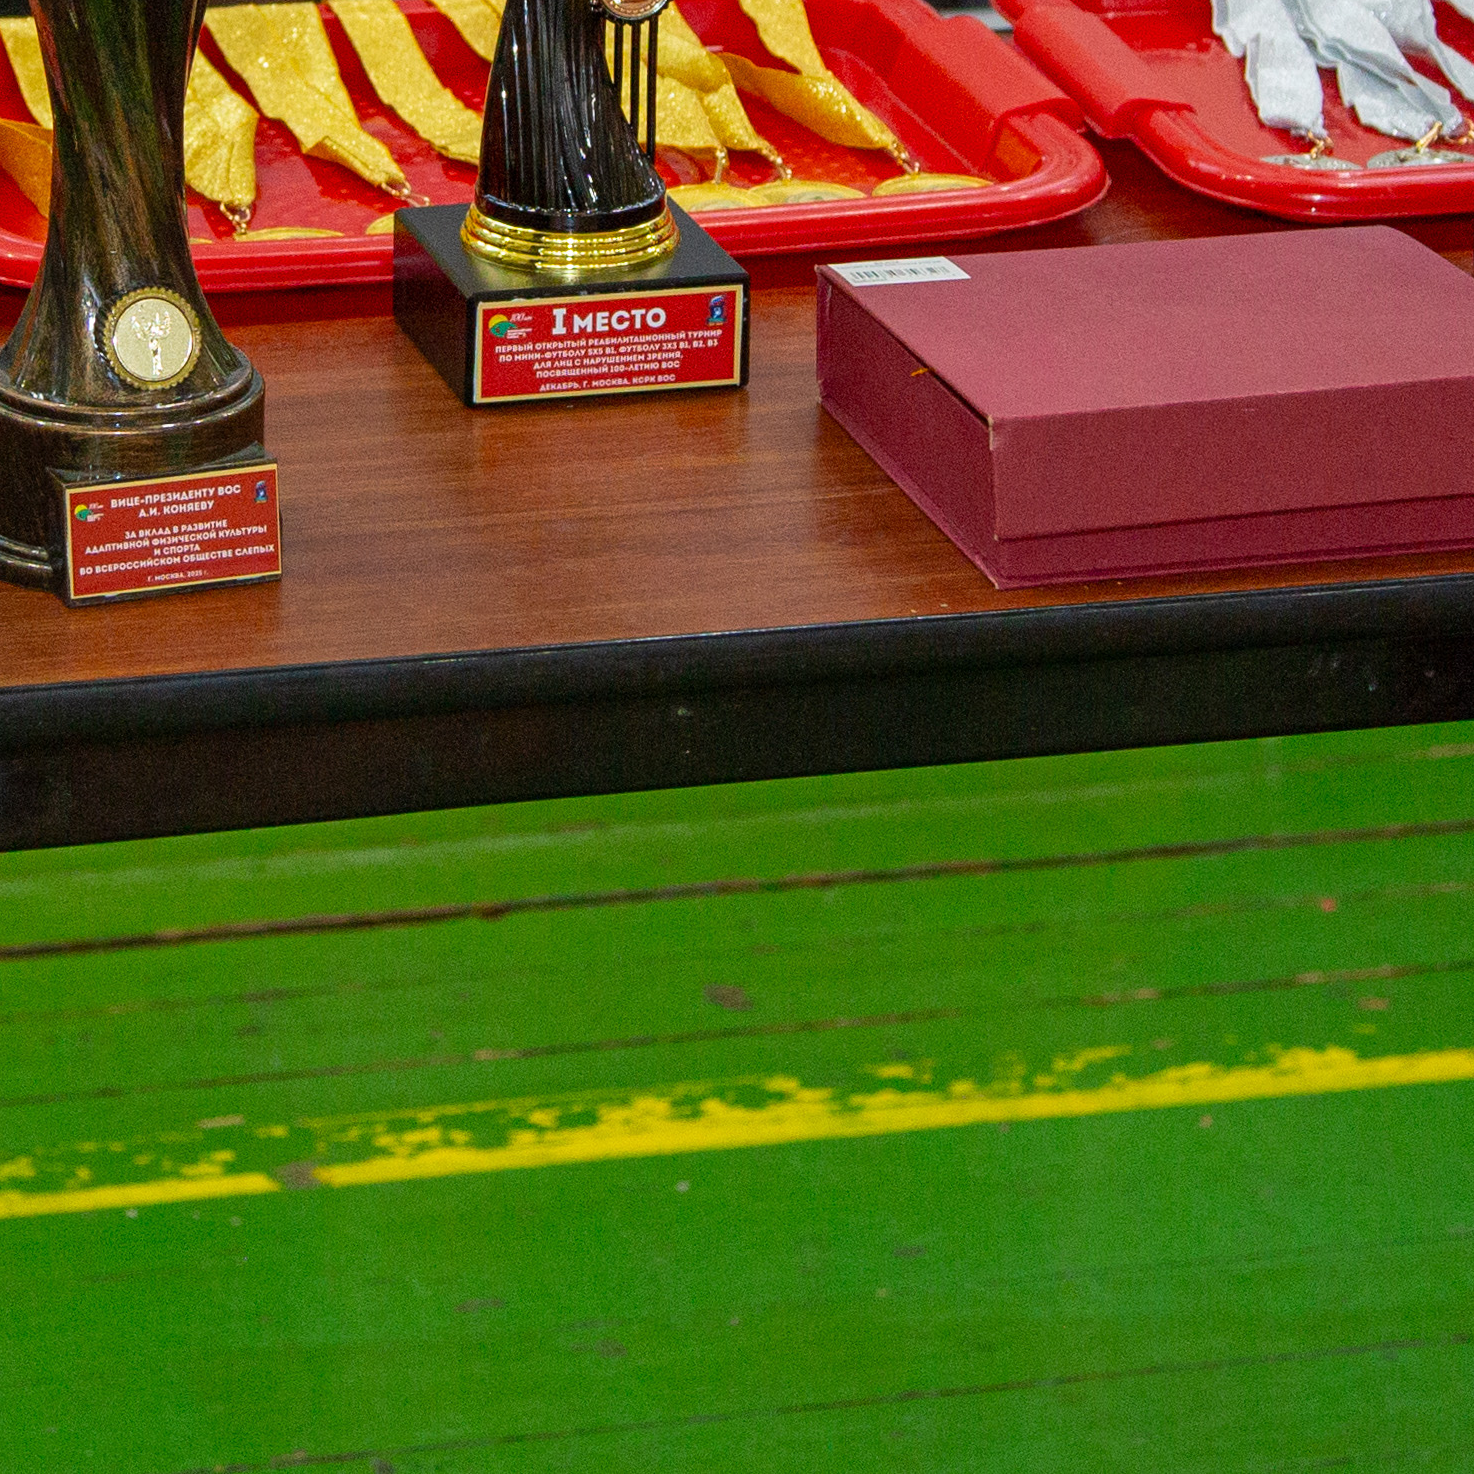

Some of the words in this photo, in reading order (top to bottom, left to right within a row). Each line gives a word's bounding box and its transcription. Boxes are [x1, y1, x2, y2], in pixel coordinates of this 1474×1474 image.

[552, 309, 567, 335] I
[573, 308, 667, 333] МЕСТО
[496, 343, 533, 353] ПЕРВЫЙ
[535, 339, 586, 351] ОТКРЫТЫЙ
[589, 332, 685, 347] РЕАБИЛИТАЦИОННЫЙ
[688, 329, 723, 339] ТУРНИР
[499, 354, 512, 363] ПО
[515, 349, 586, 361] МИНИ-ФУТБОЛУ
[619, 343, 660, 353] ФУТБОЛУ
[534, 361, 551, 369] ДЛЯ
[555, 359, 573, 368] ЛИЦ
[584, 354, 645, 366] НАРУШЕНИЕМ
[537, 365, 609, 379] ПОСВЯЩЕННЫЙ
[611, 362, 659, 372] 100-ЛЕТИЮ
[662, 360, 680, 369] ВОС
[633, 376, 656, 384] КСРК
[657, 374, 676, 382] ВОС
[111, 487, 215, 509] ВИЦЕ-ПРЕЗИДЕНТУ
[218, 485, 241, 496] ВОС
[138, 507, 161, 518] А.И.
[163, 500, 214, 515] КОНЯЕВУ
[125, 531, 137, 540] ЗА
[139, 526, 171, 538] ВКЛАД
[181, 519, 227, 532] РАЗВИТИЕ
[85, 538, 150, 555] АДАПТИВНОЙ
[152, 530, 216, 546] ФИЗИЧЕСКОЙ
[218, 525, 267, 539] КУЛЬТУРЫ
[154, 548, 161, 556] И
[163, 543, 200, 555] СПОРТА
[80, 567, 93, 575] ВО
[95, 554, 181, 574] ВСЕРОССИЙСКОМ
[183, 550, 233, 564] ОБЩЕСТВЕ
[235, 545, 274, 557] СЛЕПЫХ
